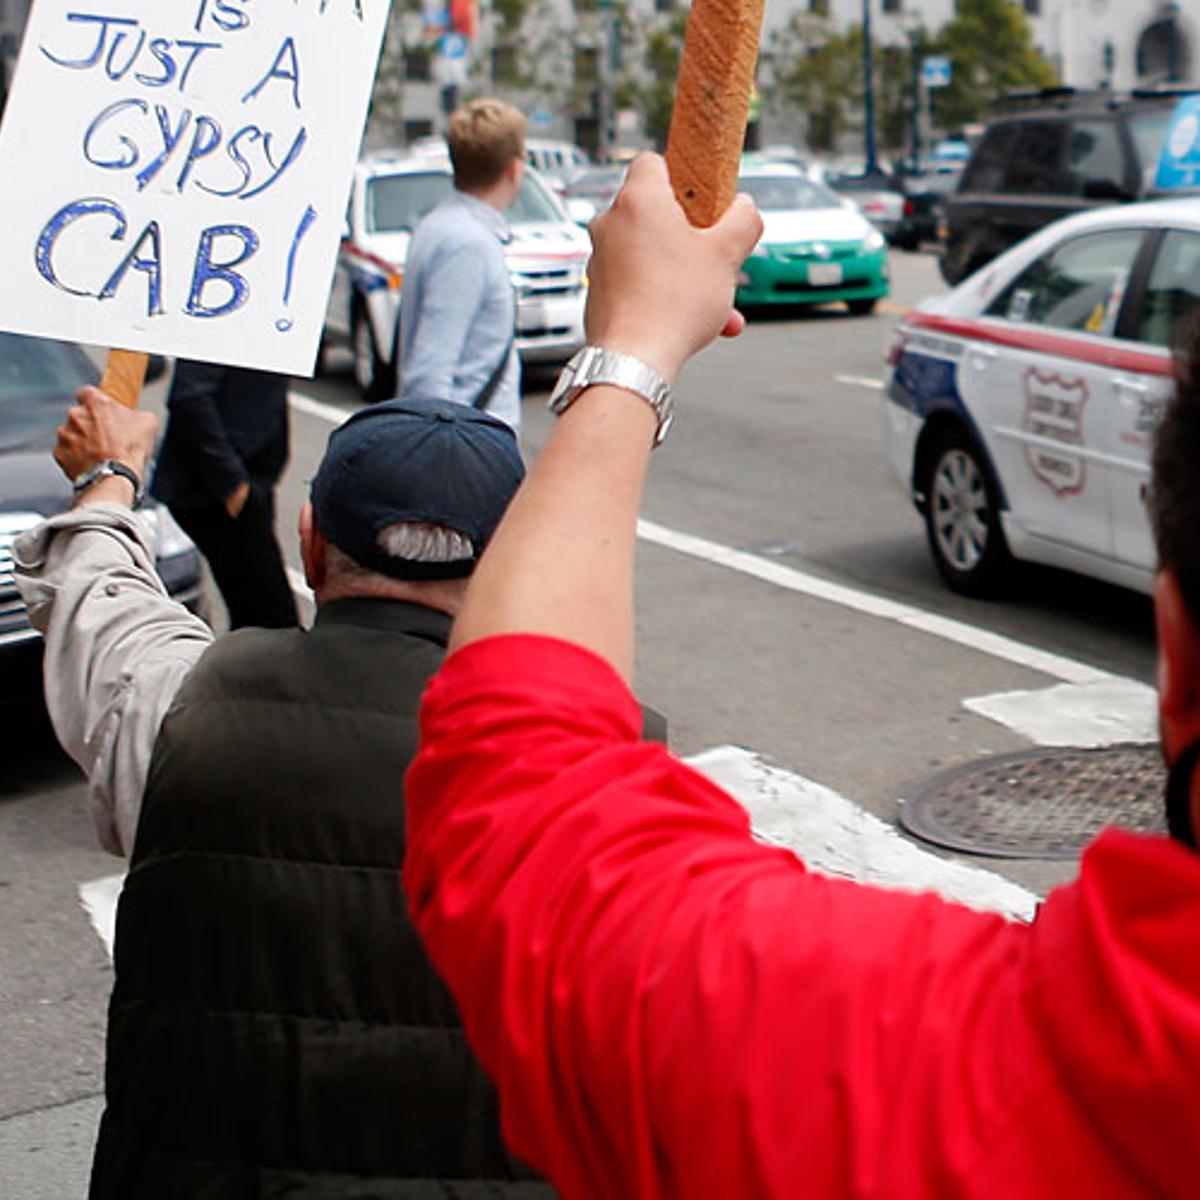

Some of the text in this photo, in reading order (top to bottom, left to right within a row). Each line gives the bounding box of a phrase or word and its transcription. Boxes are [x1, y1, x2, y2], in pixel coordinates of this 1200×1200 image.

[39, 12, 302, 109] JUST A
[82, 98, 309, 200] GYPSY
[35, 196, 319, 333] CAB!
